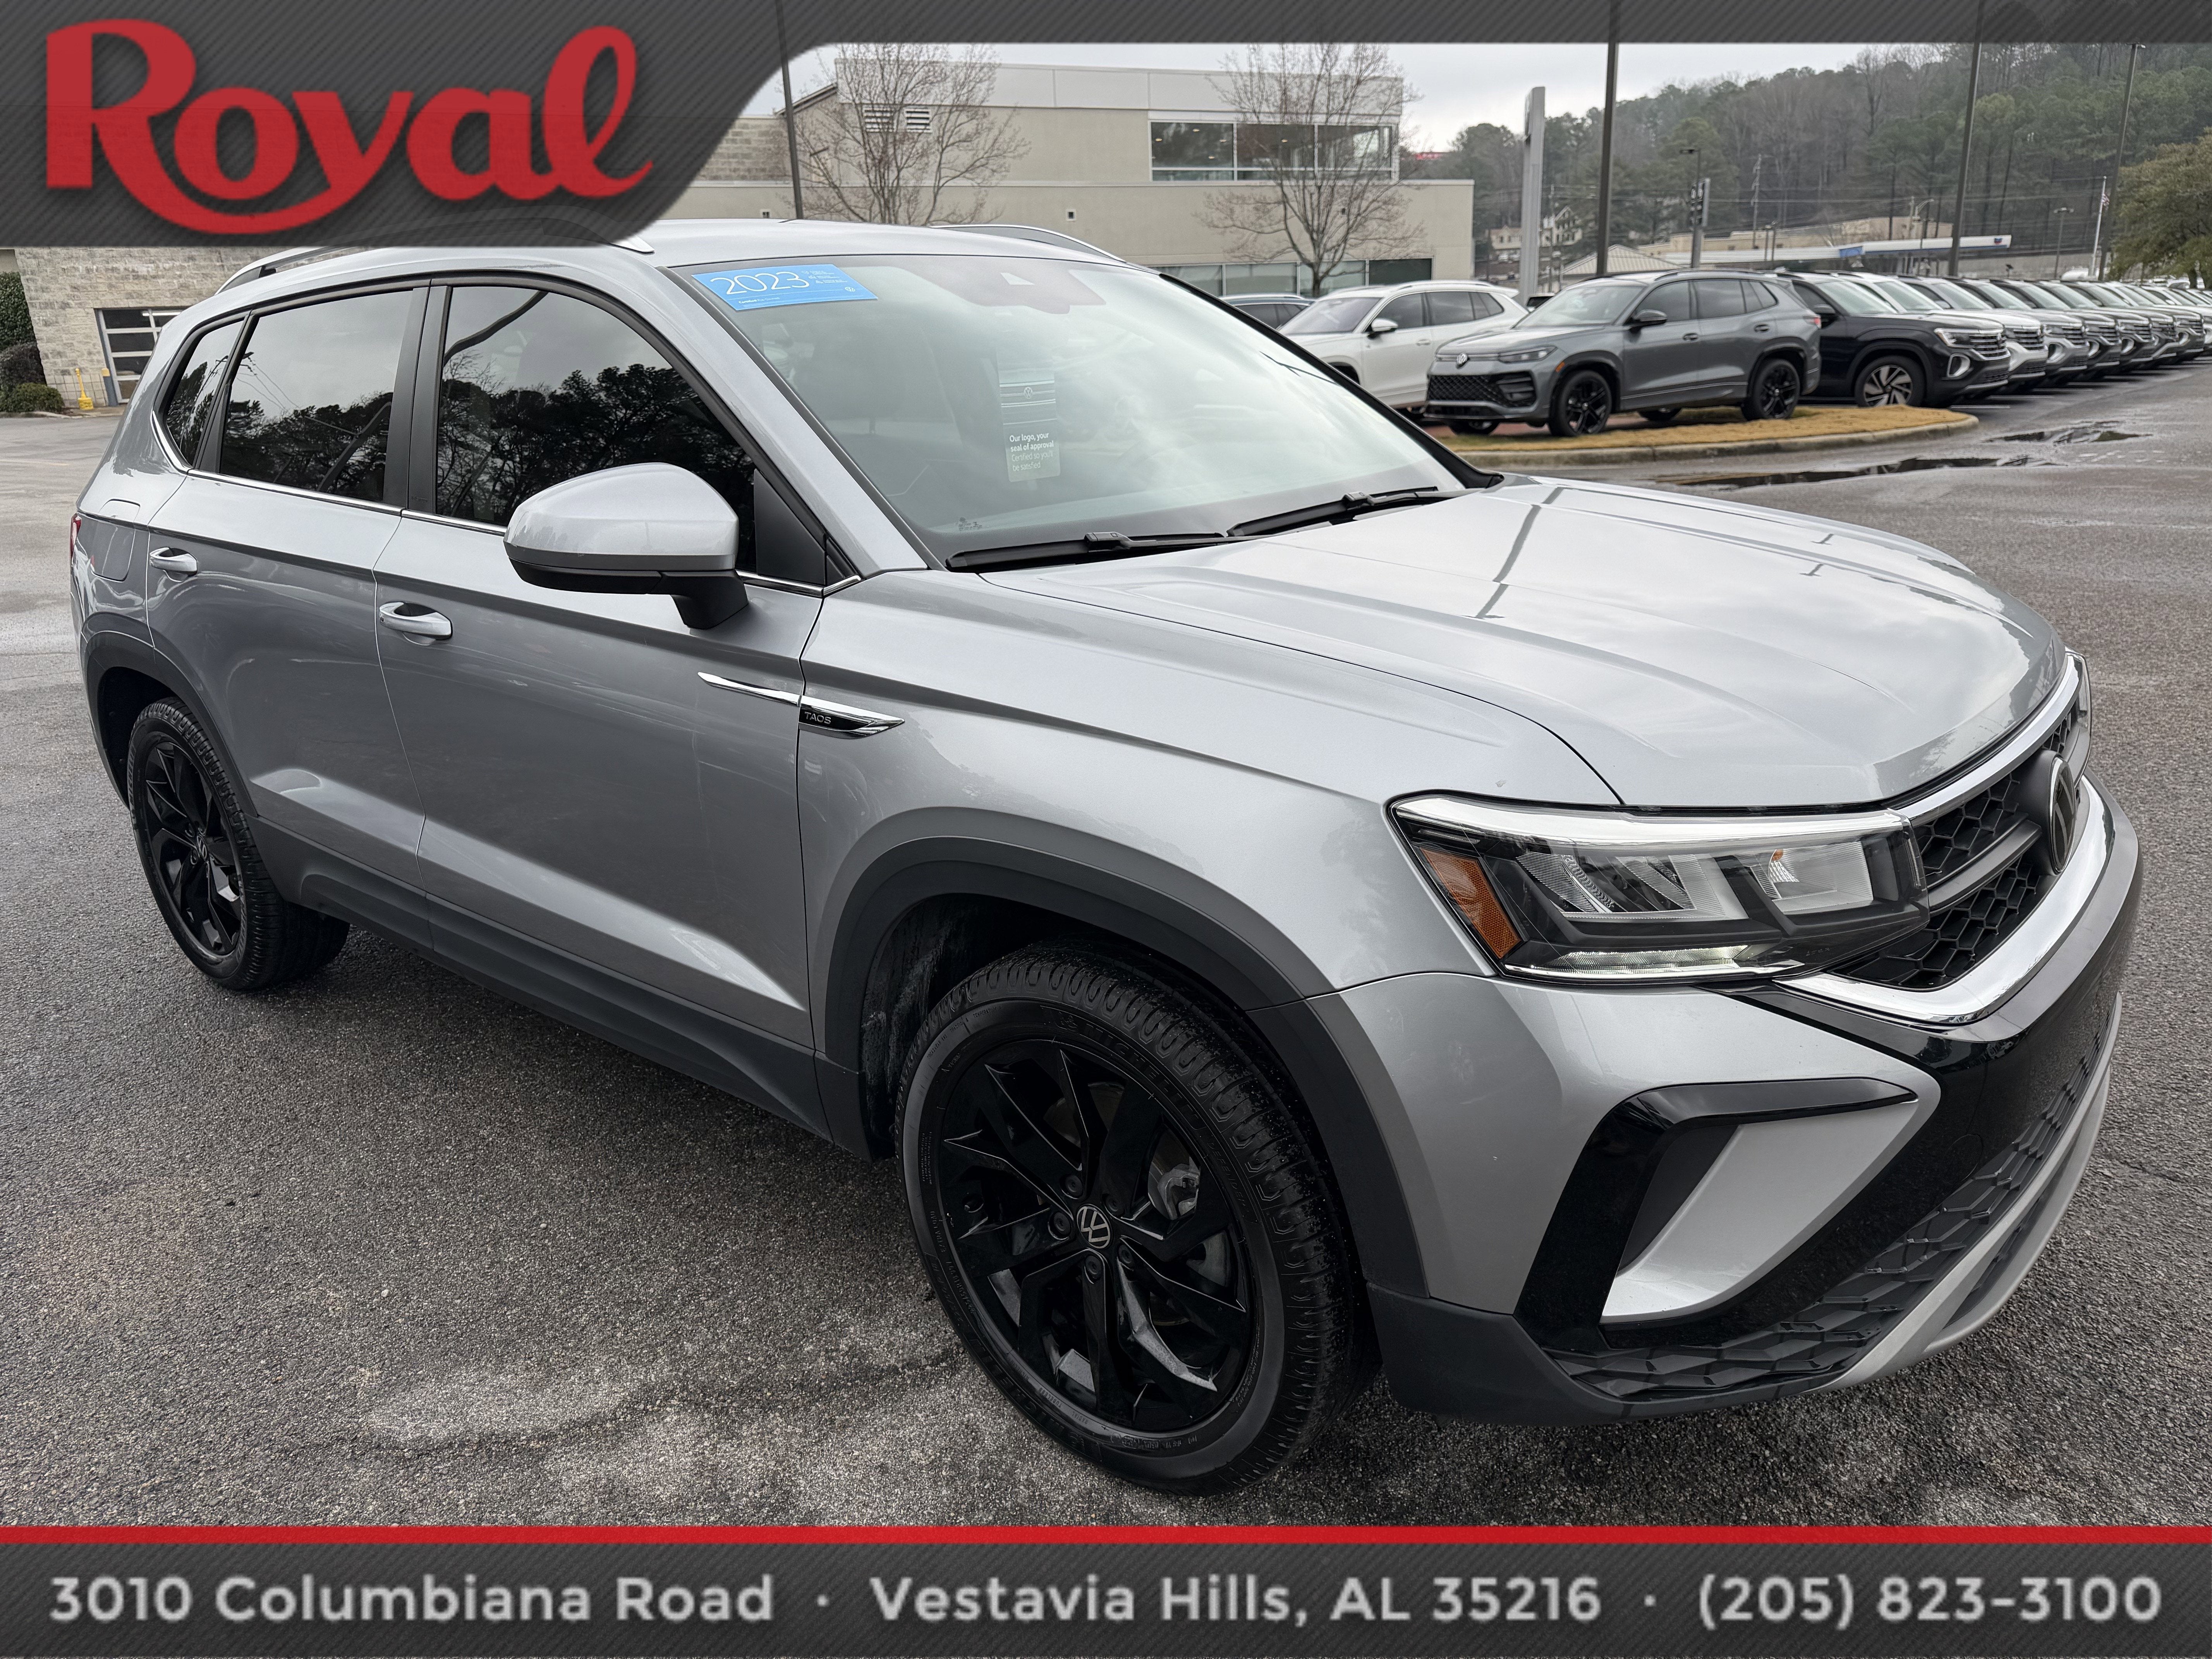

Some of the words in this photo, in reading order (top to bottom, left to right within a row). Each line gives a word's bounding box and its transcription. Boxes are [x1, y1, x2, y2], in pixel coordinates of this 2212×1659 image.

[710, 271, 809, 295] 2023
[1022, 434, 1036, 442] logo,
[1037, 433, 1049, 441] your
[1030, 440, 1054, 451] approval
[1012, 453, 1033, 462] Certified
[1020, 462, 1041, 470] satisfied
[805, 711, 831, 724] TAOS
[1079, 1020, 1200, 1128] MICHELIN
[1038, 1385, 1062, 1409] TUBELESS
